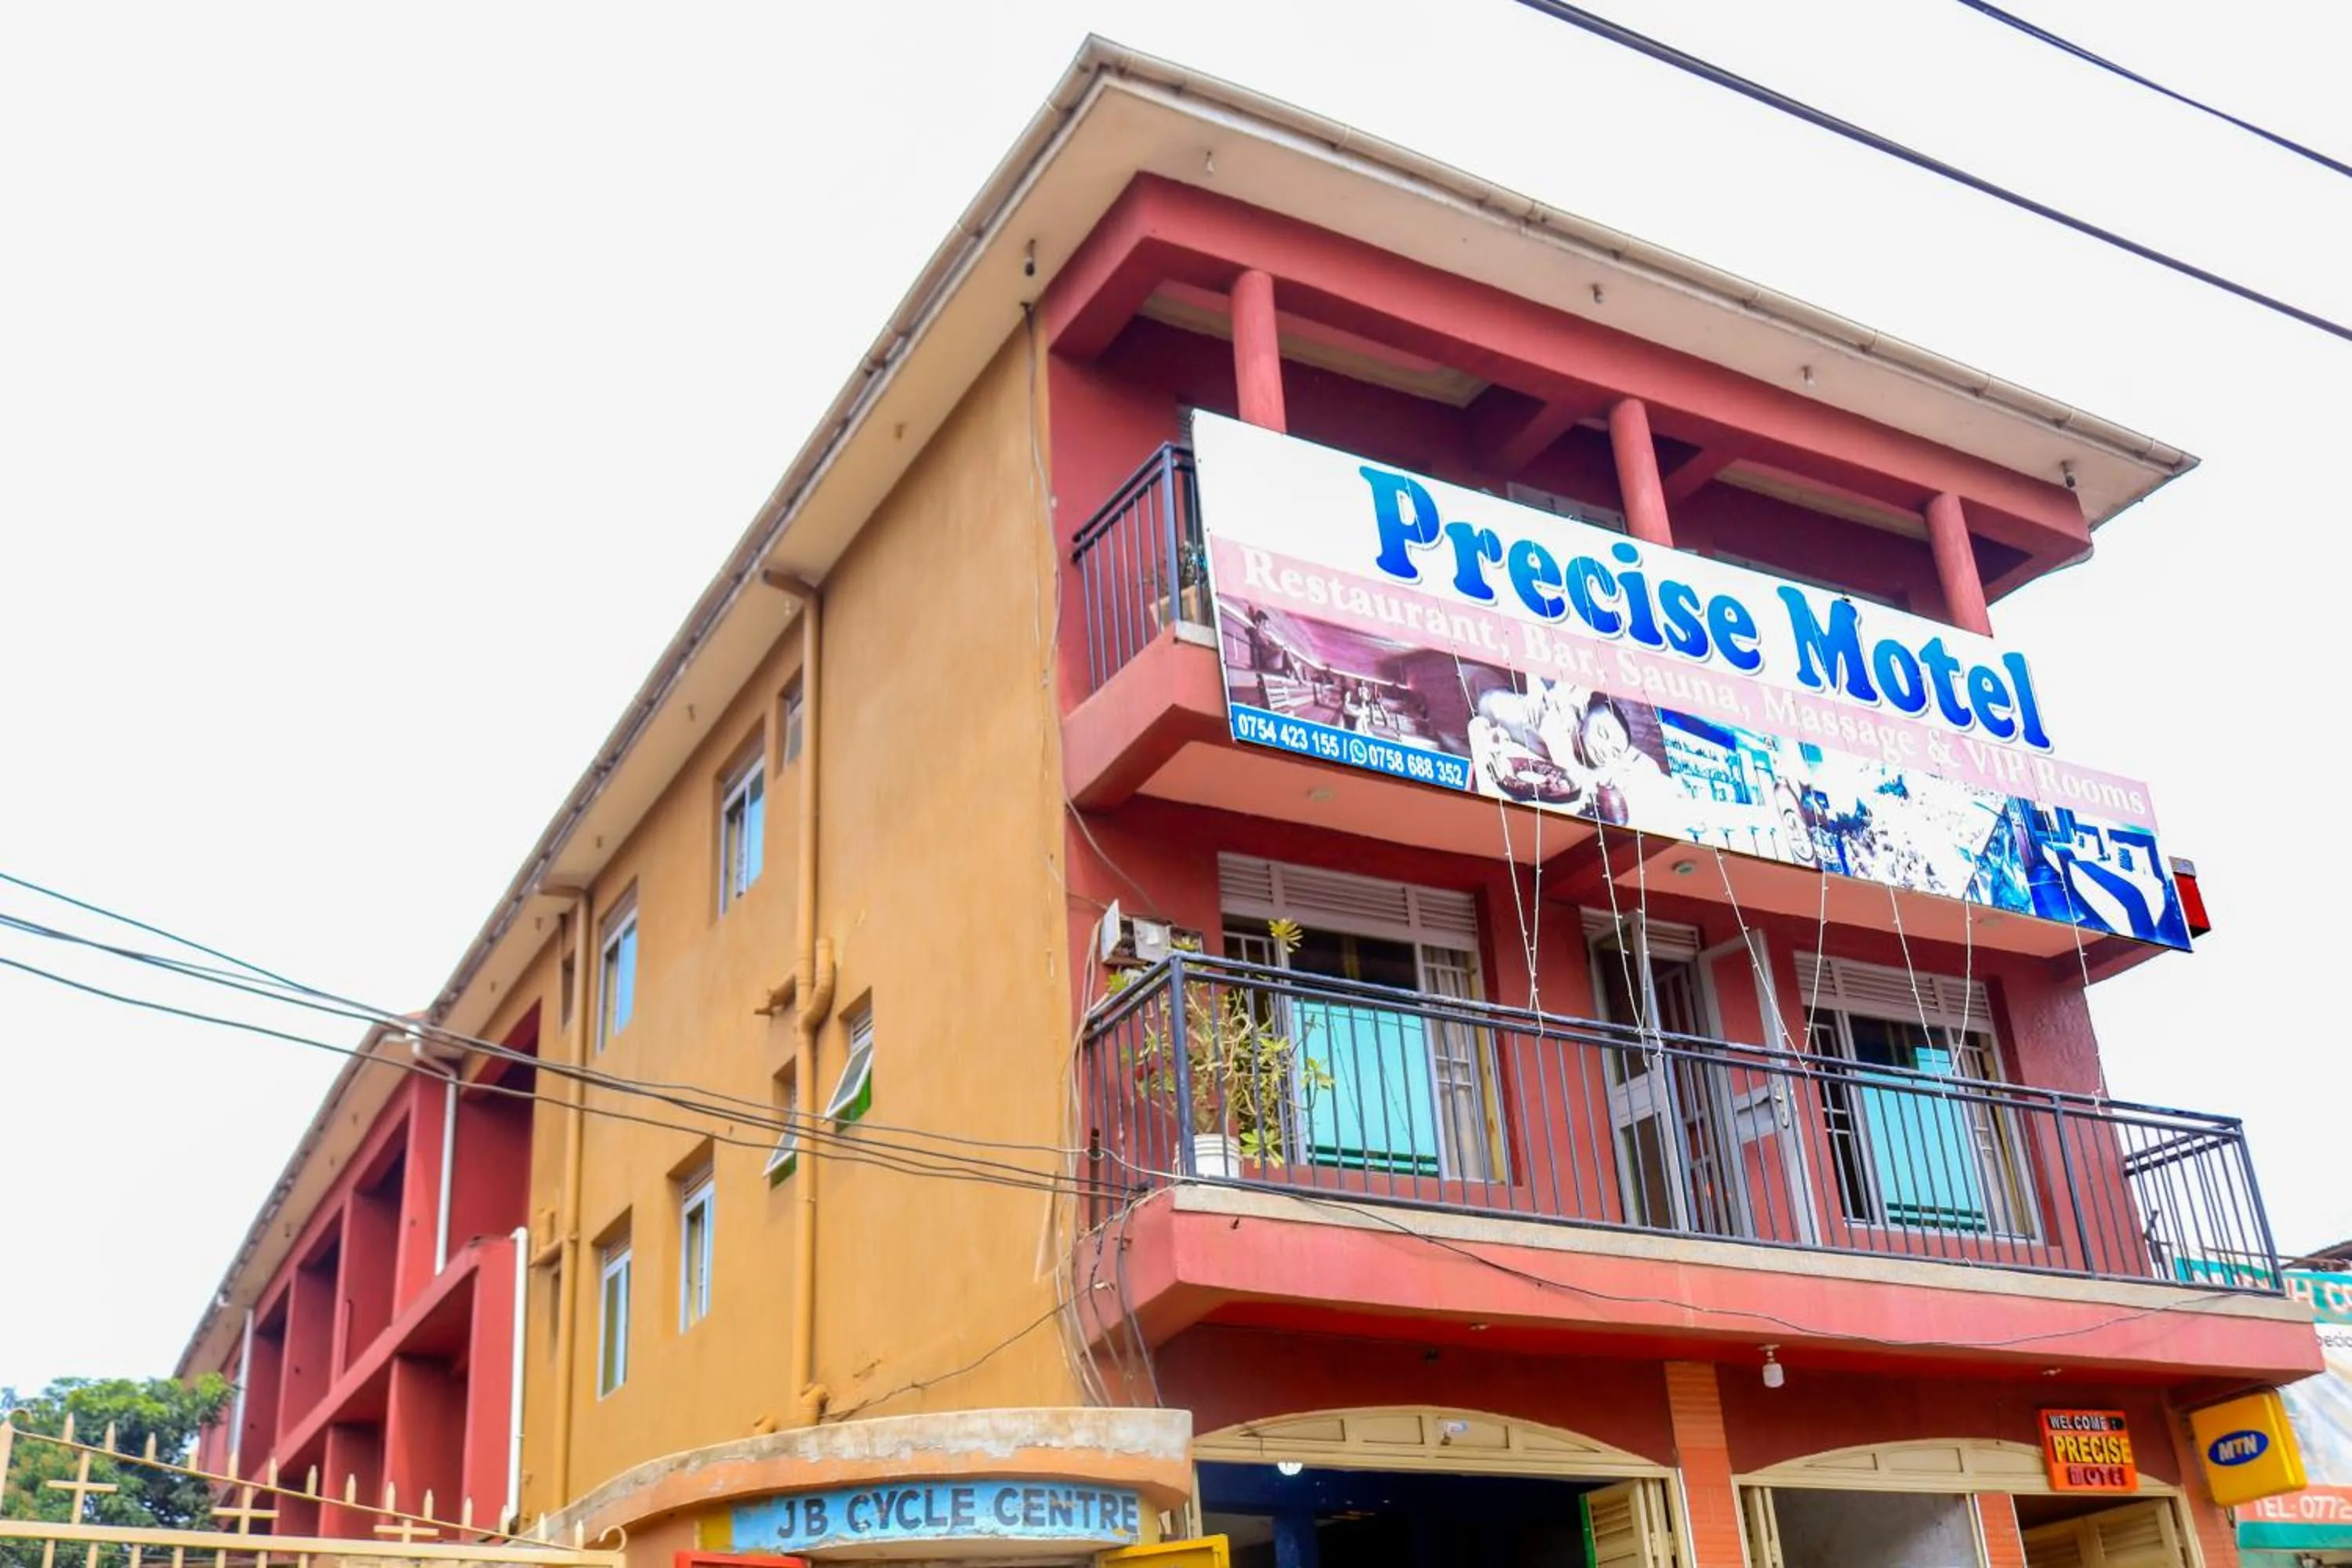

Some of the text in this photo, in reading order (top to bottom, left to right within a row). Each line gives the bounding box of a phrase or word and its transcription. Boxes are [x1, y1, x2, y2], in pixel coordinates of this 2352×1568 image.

[1359, 465, 2053, 753] Precise Motel
[1242, 549, 1510, 657] Restaurant,
[1523, 616, 1607, 681] Bar,
[1614, 649, 1752, 722] Sauna,
[1759, 685, 1918, 765] Massage
[1926, 729, 1962, 768] &
[1962, 737, 2028, 782] VIP
[2032, 757, 2147, 815] Rooms
[1238, 713, 1277, 744] 0754
[1279, 724, 1308, 750] 423
[1311, 730, 1340, 757] 155
[1368, 749, 1404, 773] 0758
[1407, 756, 1434, 780] 688
[1436, 761, 1465, 786] 352
[2048, 1414, 2107, 1432] WELCOME
[2053, 1434, 2133, 1465] PRECISE
[2217, 1433, 2258, 1463] MTN
[777, 1486, 1140, 1539] JB CYCLE CENTRE
